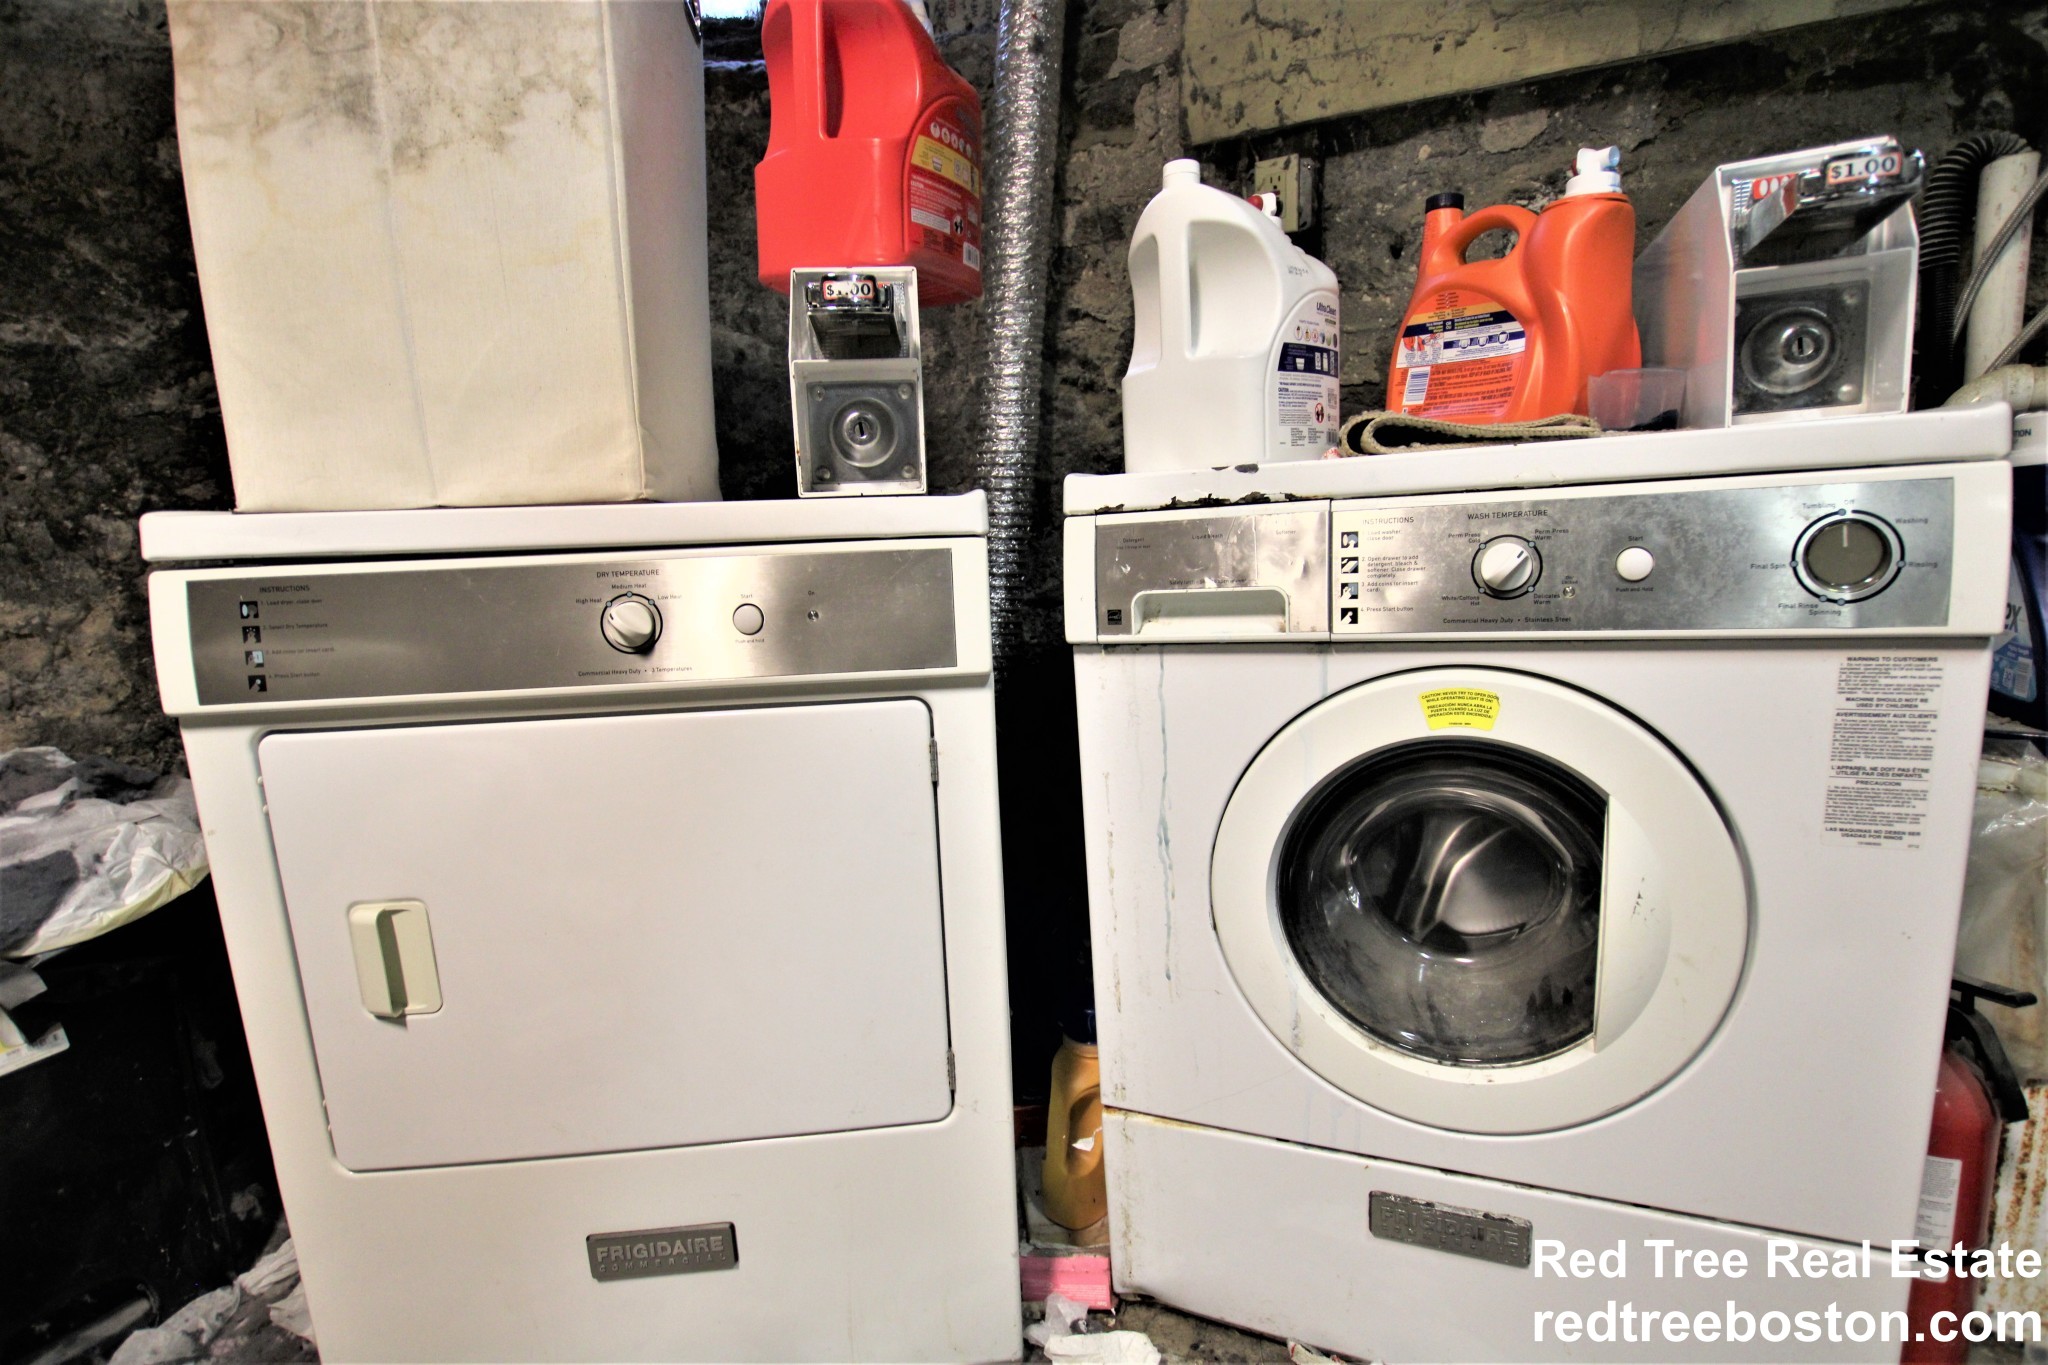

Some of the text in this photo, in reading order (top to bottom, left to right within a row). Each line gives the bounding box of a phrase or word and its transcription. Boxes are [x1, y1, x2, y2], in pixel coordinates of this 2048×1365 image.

[1830, 156, 1896, 179] $1.00
[1802, 502, 1836, 510] Tumbling
[1467, 509, 1549, 521] WASH TEMPERATURE
[1362, 516, 1415, 525] INSTRUCTIONS
[1895, 517, 1929, 525] Washing
[1769, 562, 1787, 570] Spin
[596, 569, 660, 579] DRY TEMPERATURE
[259, 584, 311, 593] INSTRUCTIONS
[1808, 609, 1842, 617] Spinning
[578, 669, 611, 677] Commercial
[611, 668, 628, 676] Heavy
[656, 666, 693, 674] Temperatures
[596, 1235, 724, 1263] FRIGIDAIRE
[599, 1254, 727, 1273] COMMERCIAL
